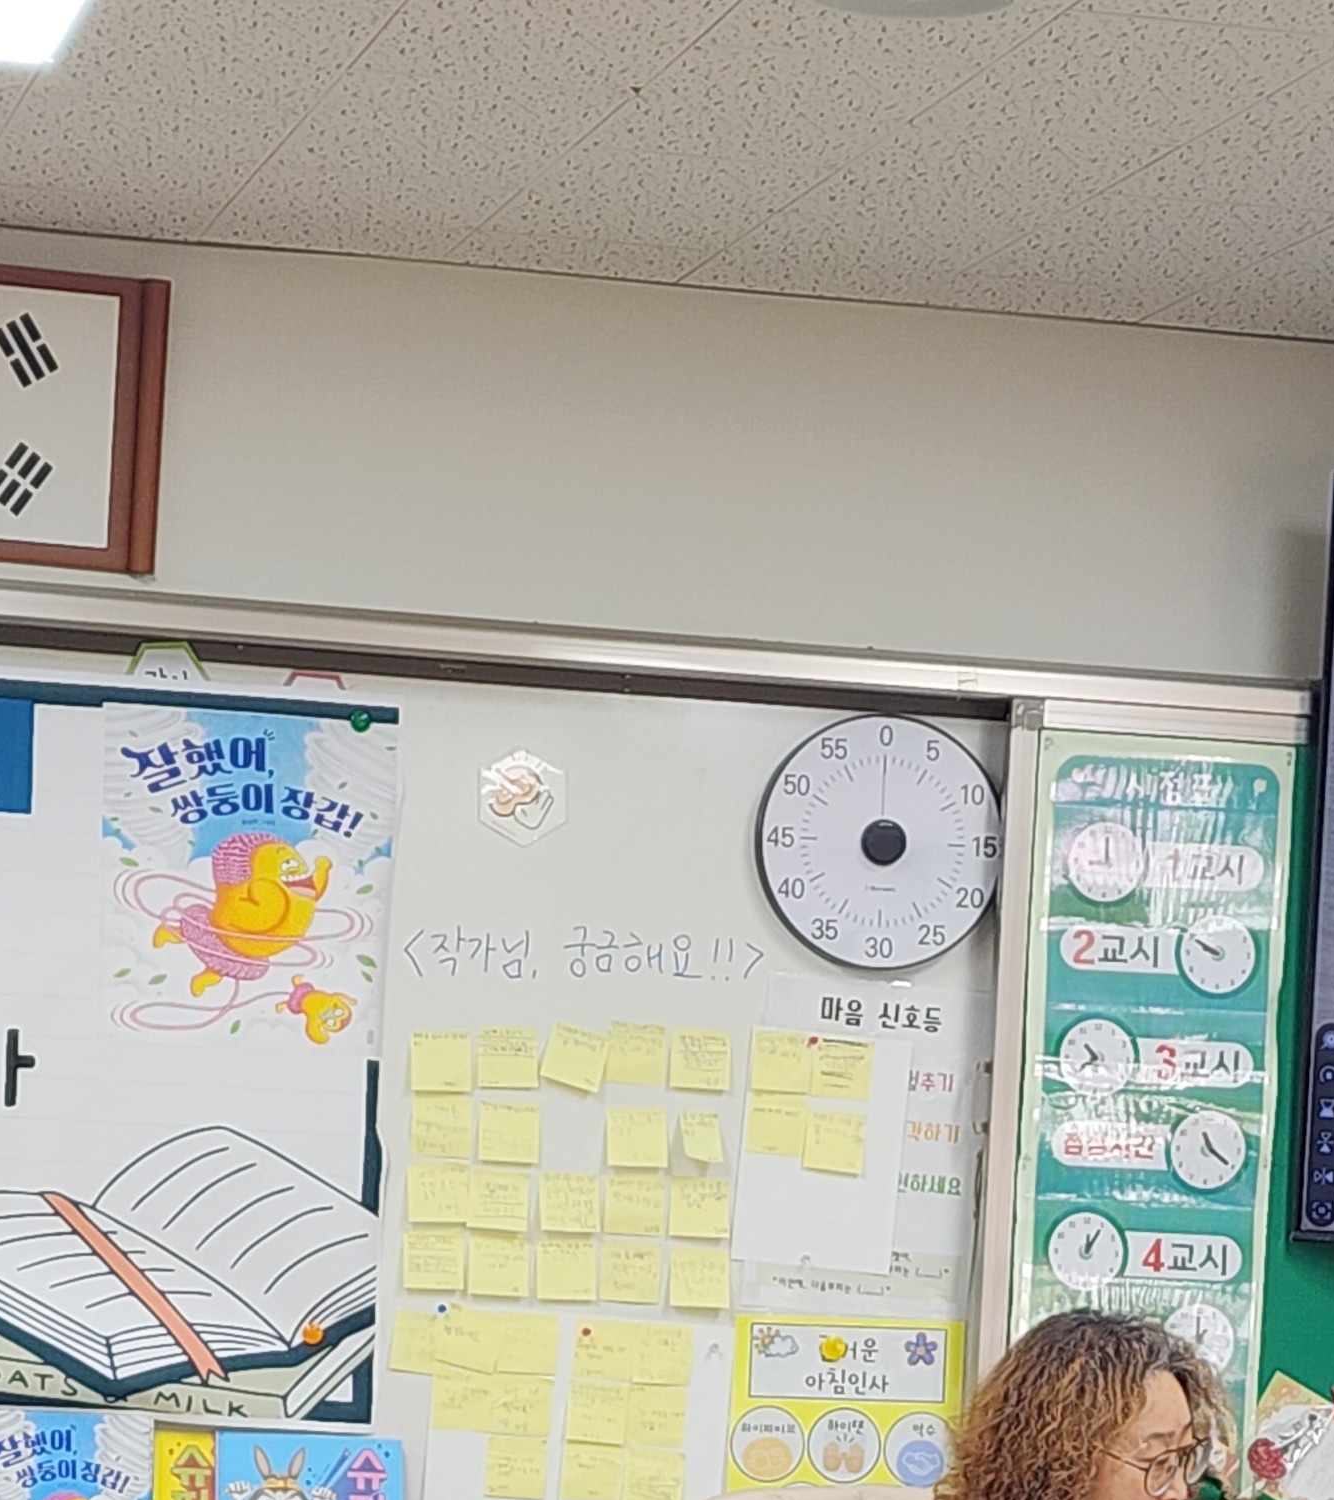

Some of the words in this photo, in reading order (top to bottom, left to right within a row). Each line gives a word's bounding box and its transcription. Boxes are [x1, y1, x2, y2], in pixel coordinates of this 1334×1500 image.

[879, 725, 893, 747] 0
[820, 738, 848, 760] 55
[926, 740, 940, 761] 5
[120, 730, 275, 794] 잘했어,
[783, 774, 810, 796] 50
[960, 784, 985, 806] 10
[767, 826, 795, 848] 45
[971, 835, 998, 858] 15
[777, 877, 805, 900] 40
[956, 887, 985, 909] 20
[811, 918, 838, 941] 35
[918, 924, 945, 946] 25
[403, 929, 538, 979] <작가님,
[564, 926, 766, 980] 궁금해요!!>
[864, 937, 893, 959] 30
[1072, 930, 1159, 968] 2교시
[821, 996, 864, 1027] 마음
[878, 1001, 943, 1034] 신호등
[1154, 1044, 1240, 1083] 3교시
[1141, 1238, 1228, 1277] 4교시
[805, 1367, 889, 1395] 아침인사
[154, 1391, 249, 1418] MILK
